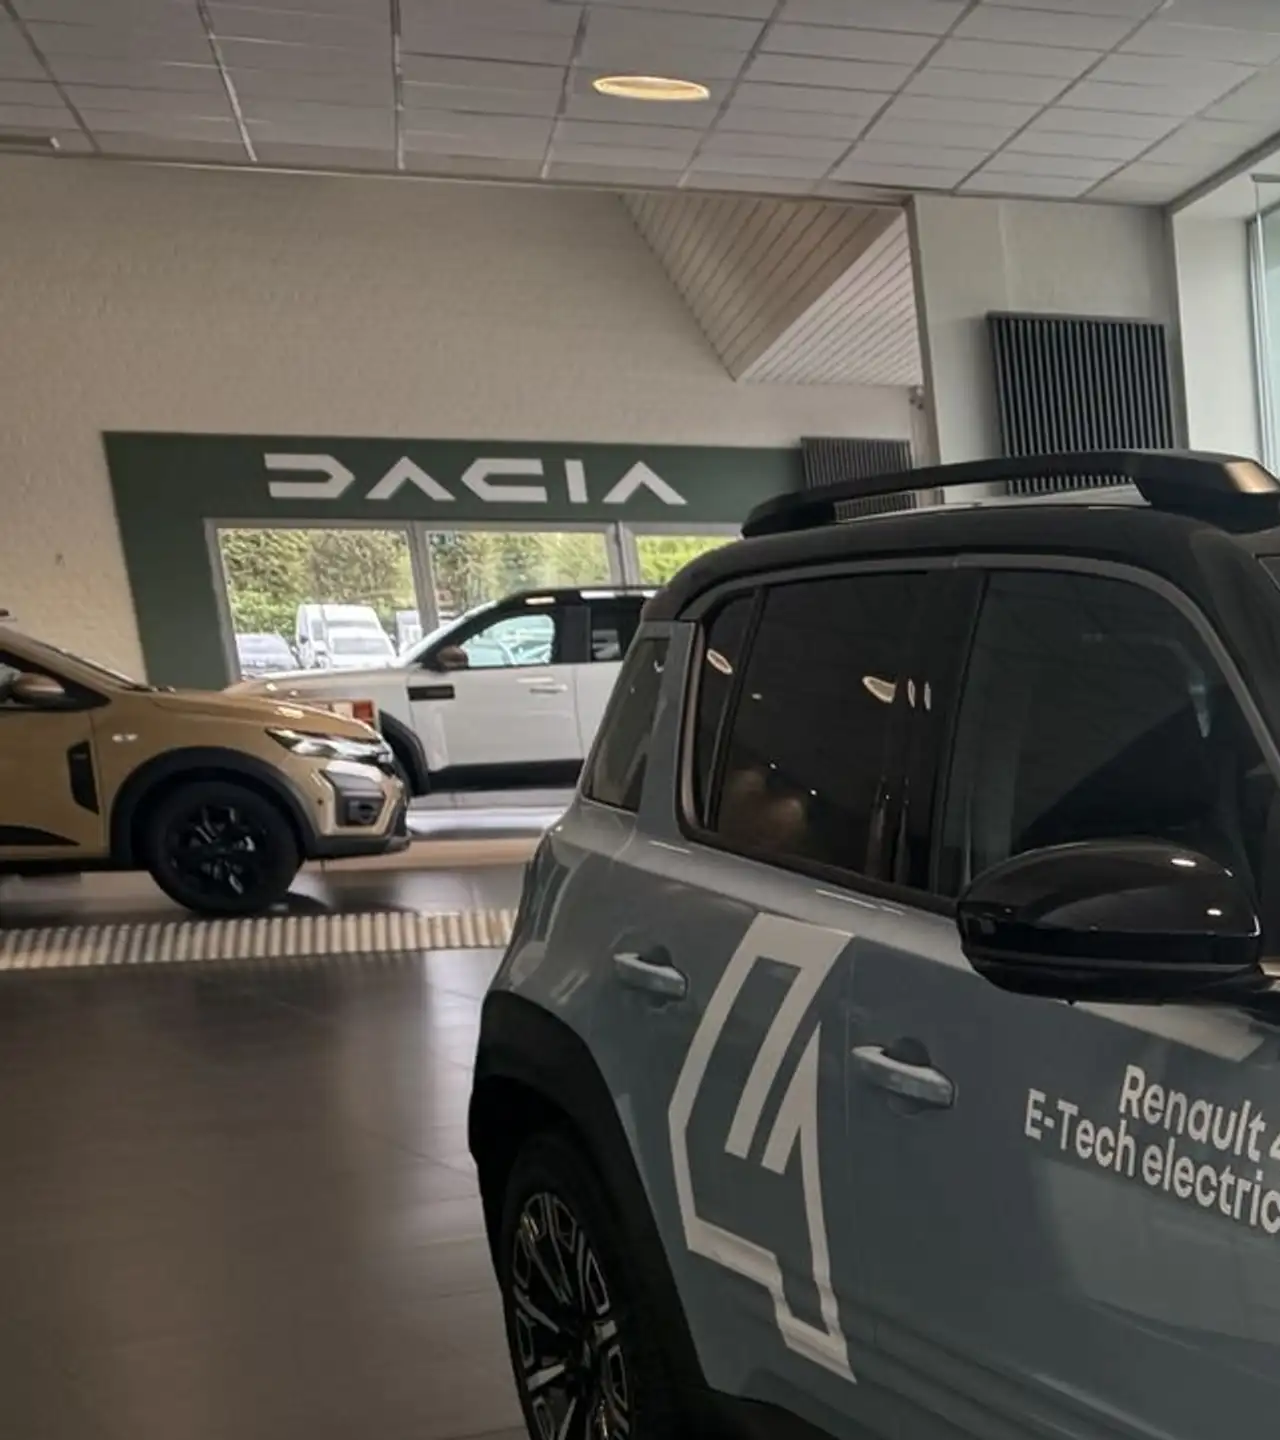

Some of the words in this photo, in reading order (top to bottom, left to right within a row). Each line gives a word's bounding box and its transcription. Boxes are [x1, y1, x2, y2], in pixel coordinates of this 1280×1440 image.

[264, 453, 688, 505] DACIA
[1024, 1088, 1136, 1177] E-Tech
[1119, 1064, 1267, 1163] Renault
